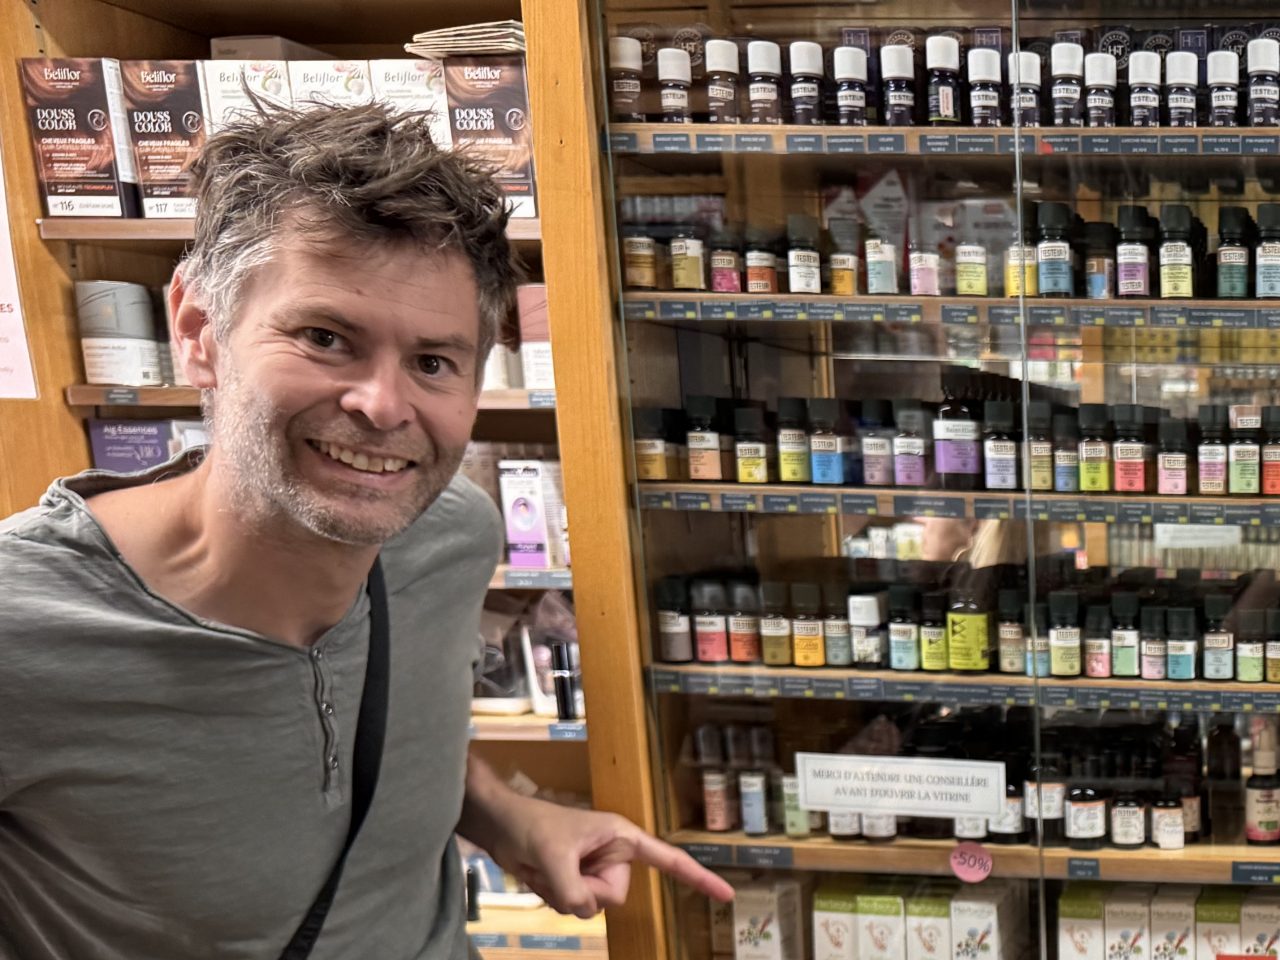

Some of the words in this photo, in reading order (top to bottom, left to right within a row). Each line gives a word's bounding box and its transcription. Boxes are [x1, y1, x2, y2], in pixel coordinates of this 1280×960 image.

[219, 72, 260, 84] Belior
[37, 108, 75, 120] DOUSS
[134, 111, 170, 122] DOUSS
[455, 108, 494, 120] DOUSS
[38, 119, 76, 131] COLOR
[134, 122, 172, 133] COLOR
[456, 120, 494, 130] COLOR
[812, 769, 842, 779] MERCI
[844, 770, 901, 783] D'ATTENDRE
[904, 774, 924, 784] UNE
[834, 786, 868, 796] AVANT
[870, 788, 916, 800] D'OUVRIR
[918, 790, 932, 800] LA
[933, 790, 972, 802] VITRINE
